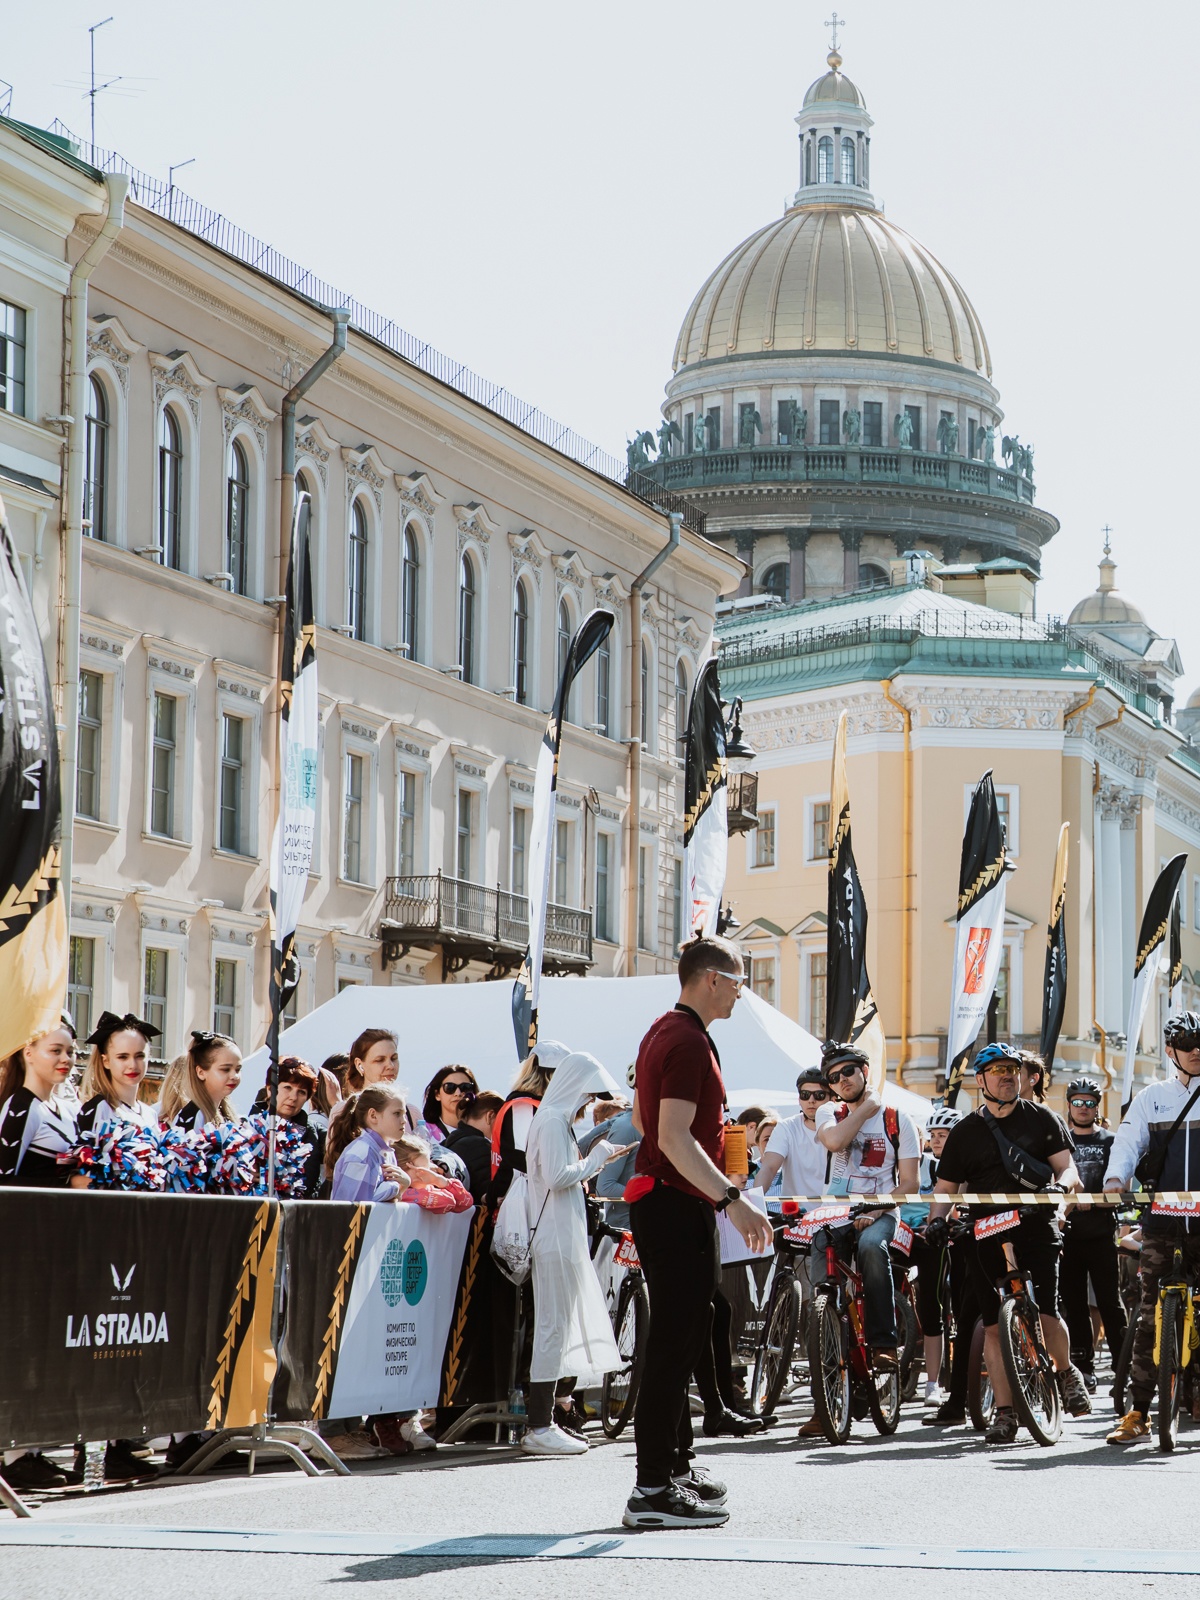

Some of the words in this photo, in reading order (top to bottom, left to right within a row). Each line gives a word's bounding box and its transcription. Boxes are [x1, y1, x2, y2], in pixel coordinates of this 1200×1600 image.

[22, 759, 41, 810] LA
[66, 1314, 91, 1347] LA
[95, 1312, 169, 1346] STRADA
[387, 1323, 407, 1333] КОМИТЕТ
[409, 1322, 415, 1332] ПО
[386, 1334, 416, 1347] ФИЗИЧЕСКОЙ
[93, 1350, 143, 1359] ВЕЛОГОНКА
[385, 1351, 408, 1361] КУЛЬТУРЕ
[385, 1367, 389, 1376] И
[390, 1365, 408, 1376] СПОРТУ
